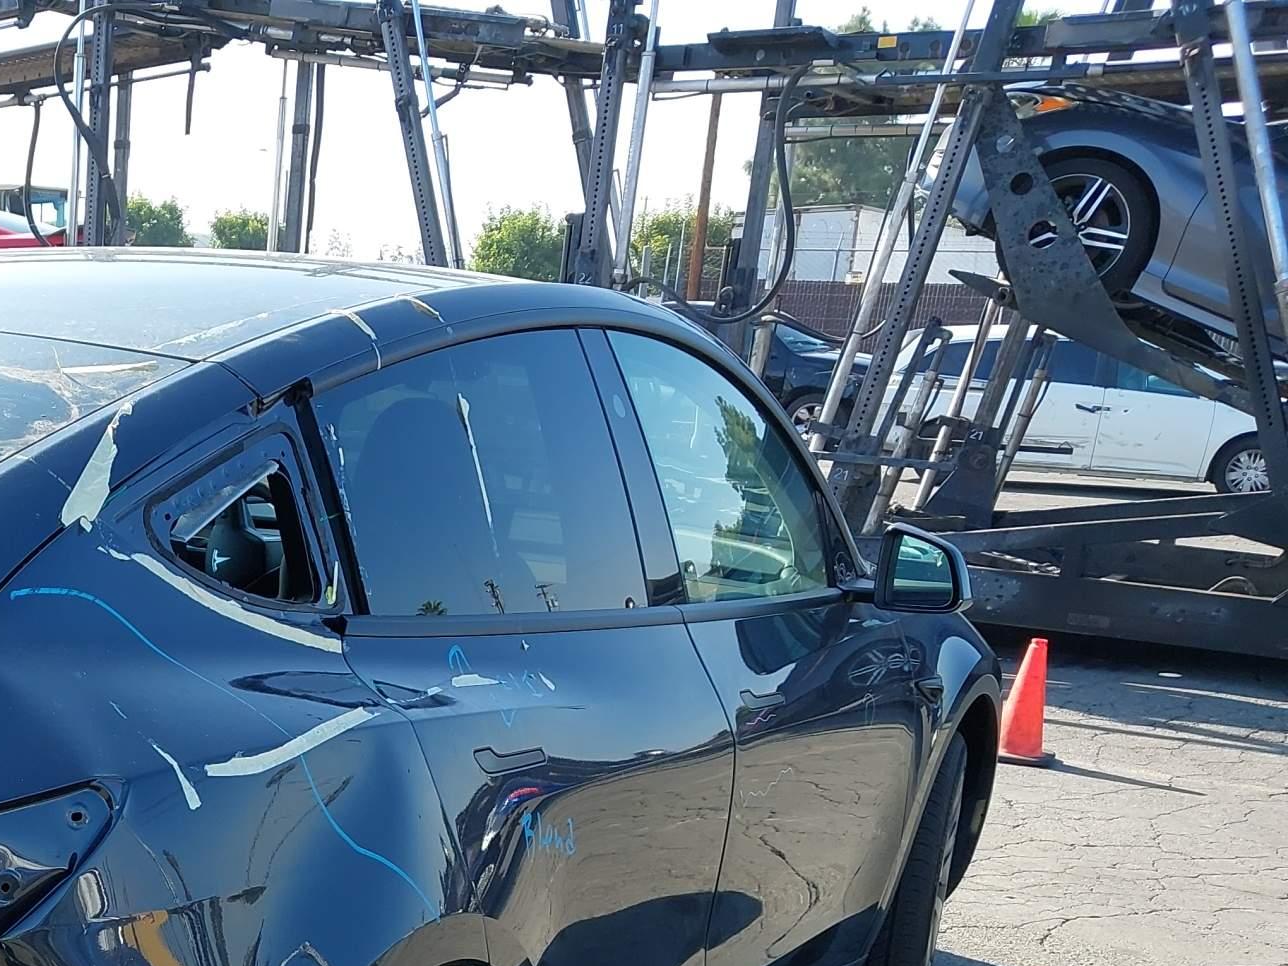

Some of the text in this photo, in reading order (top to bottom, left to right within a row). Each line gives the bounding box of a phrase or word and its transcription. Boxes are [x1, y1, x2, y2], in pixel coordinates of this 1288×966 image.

[612, 23, 624, 35] 11
[968, 428, 984, 441] 21
[833, 467, 849, 481] 21
